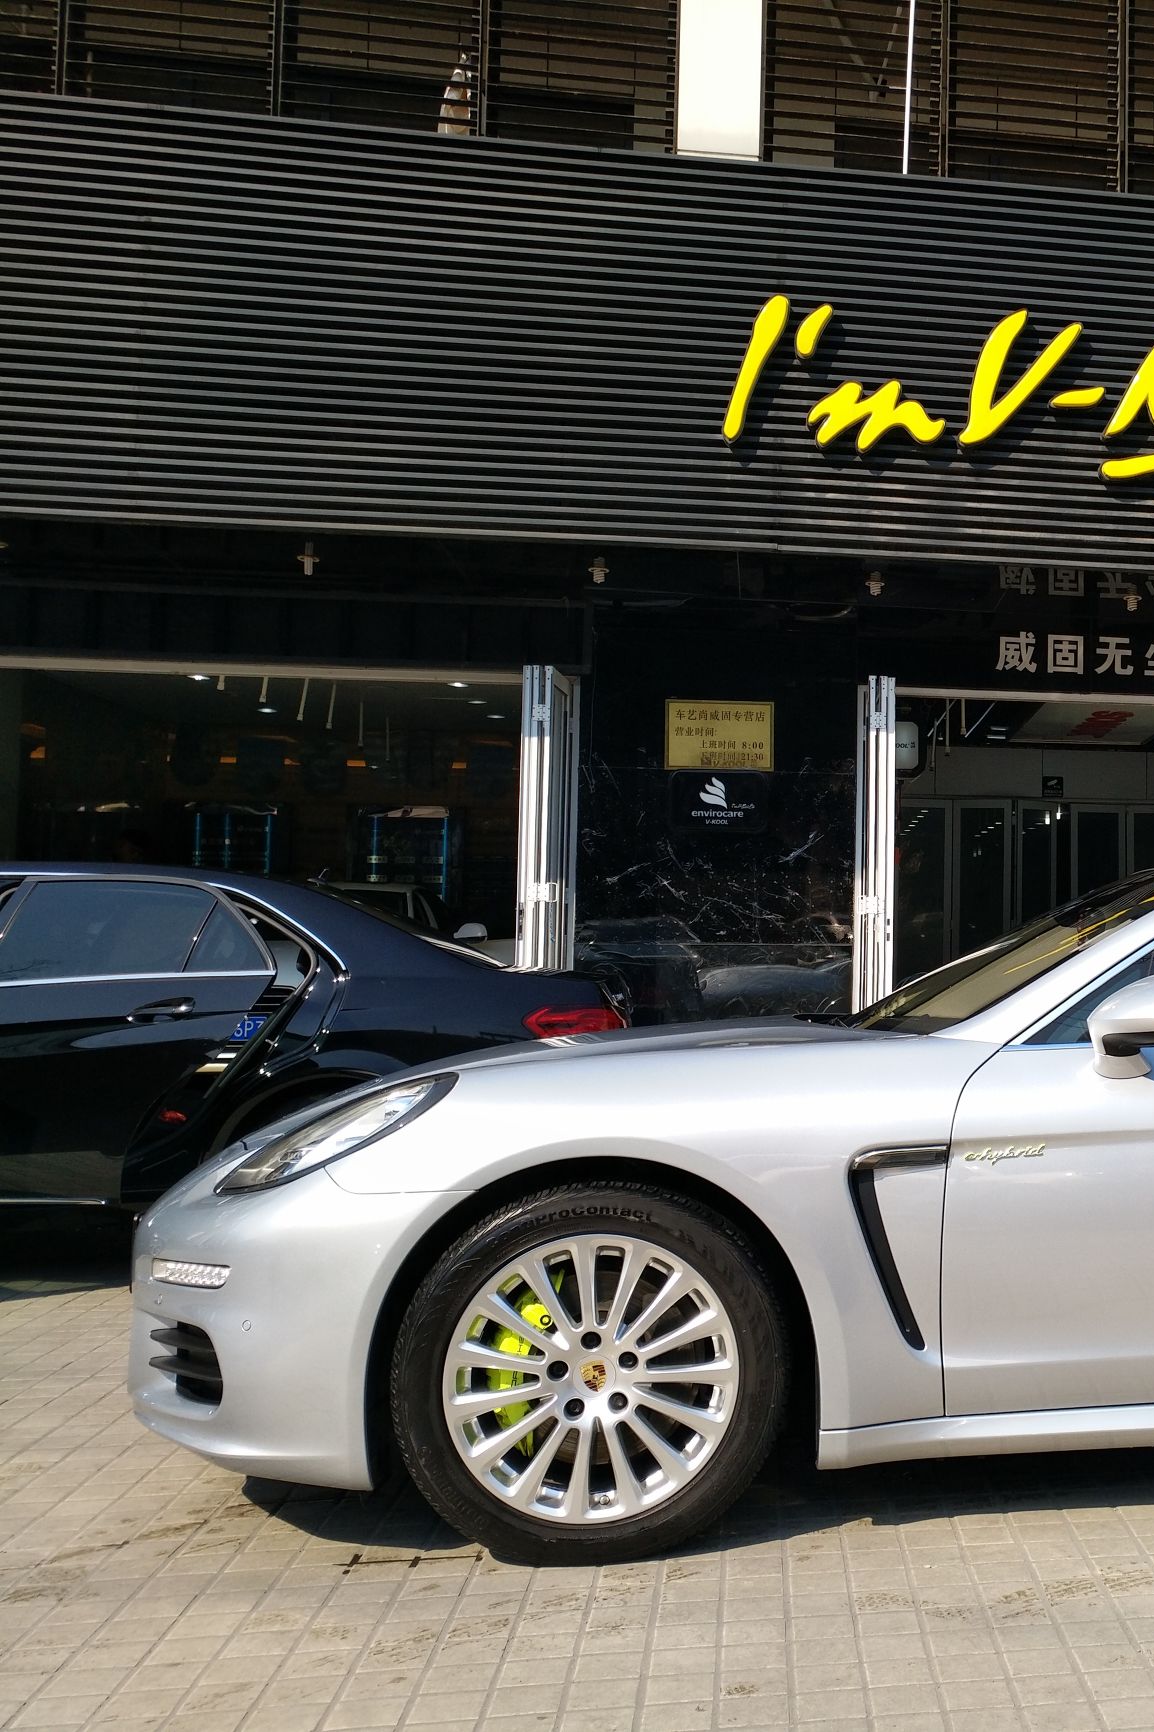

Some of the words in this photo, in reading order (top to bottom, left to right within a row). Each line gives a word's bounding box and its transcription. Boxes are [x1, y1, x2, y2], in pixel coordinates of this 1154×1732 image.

[722, 294, 946, 452] I'm
[741, 741, 764, 750] 8:00
[741, 752, 764, 761] 21:30
[691, 808, 744, 818] envirocare
